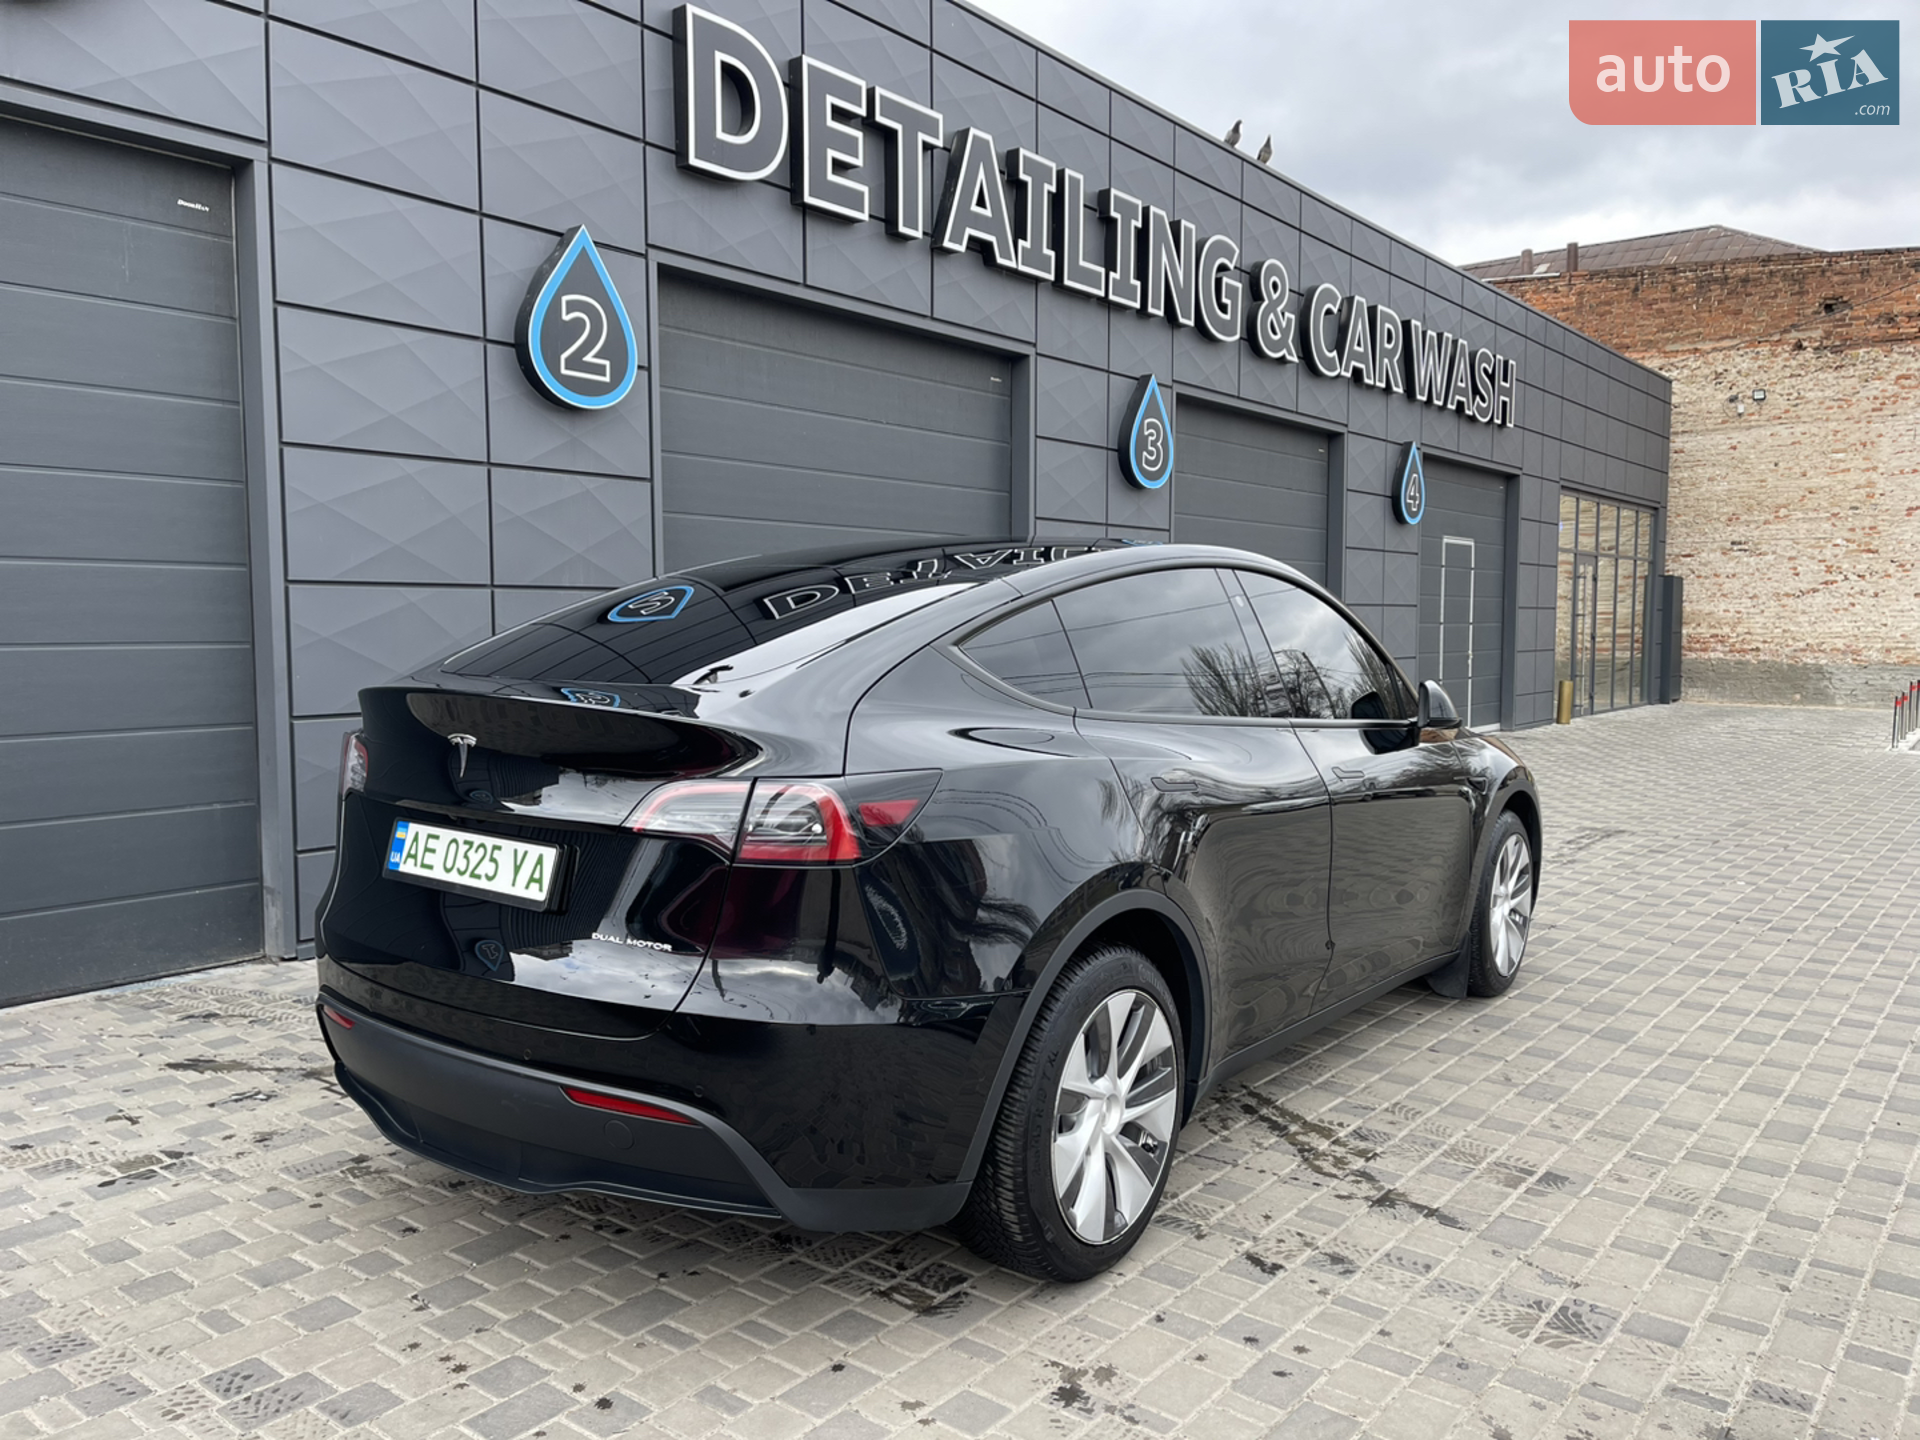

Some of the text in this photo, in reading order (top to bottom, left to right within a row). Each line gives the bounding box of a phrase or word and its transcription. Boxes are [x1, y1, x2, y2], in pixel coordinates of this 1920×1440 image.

[676, 3, 1516, 428] DETAILING & CAR WASH
[560, 294, 610, 382] 2
[1142, 418, 1164, 471] 3
[1406, 473, 1420, 511] 4
[403, 831, 441, 870] AE
[443, 837, 502, 882] 0325
[511, 848, 544, 892] YA
[592, 932, 673, 952] DUAL MOTOR
